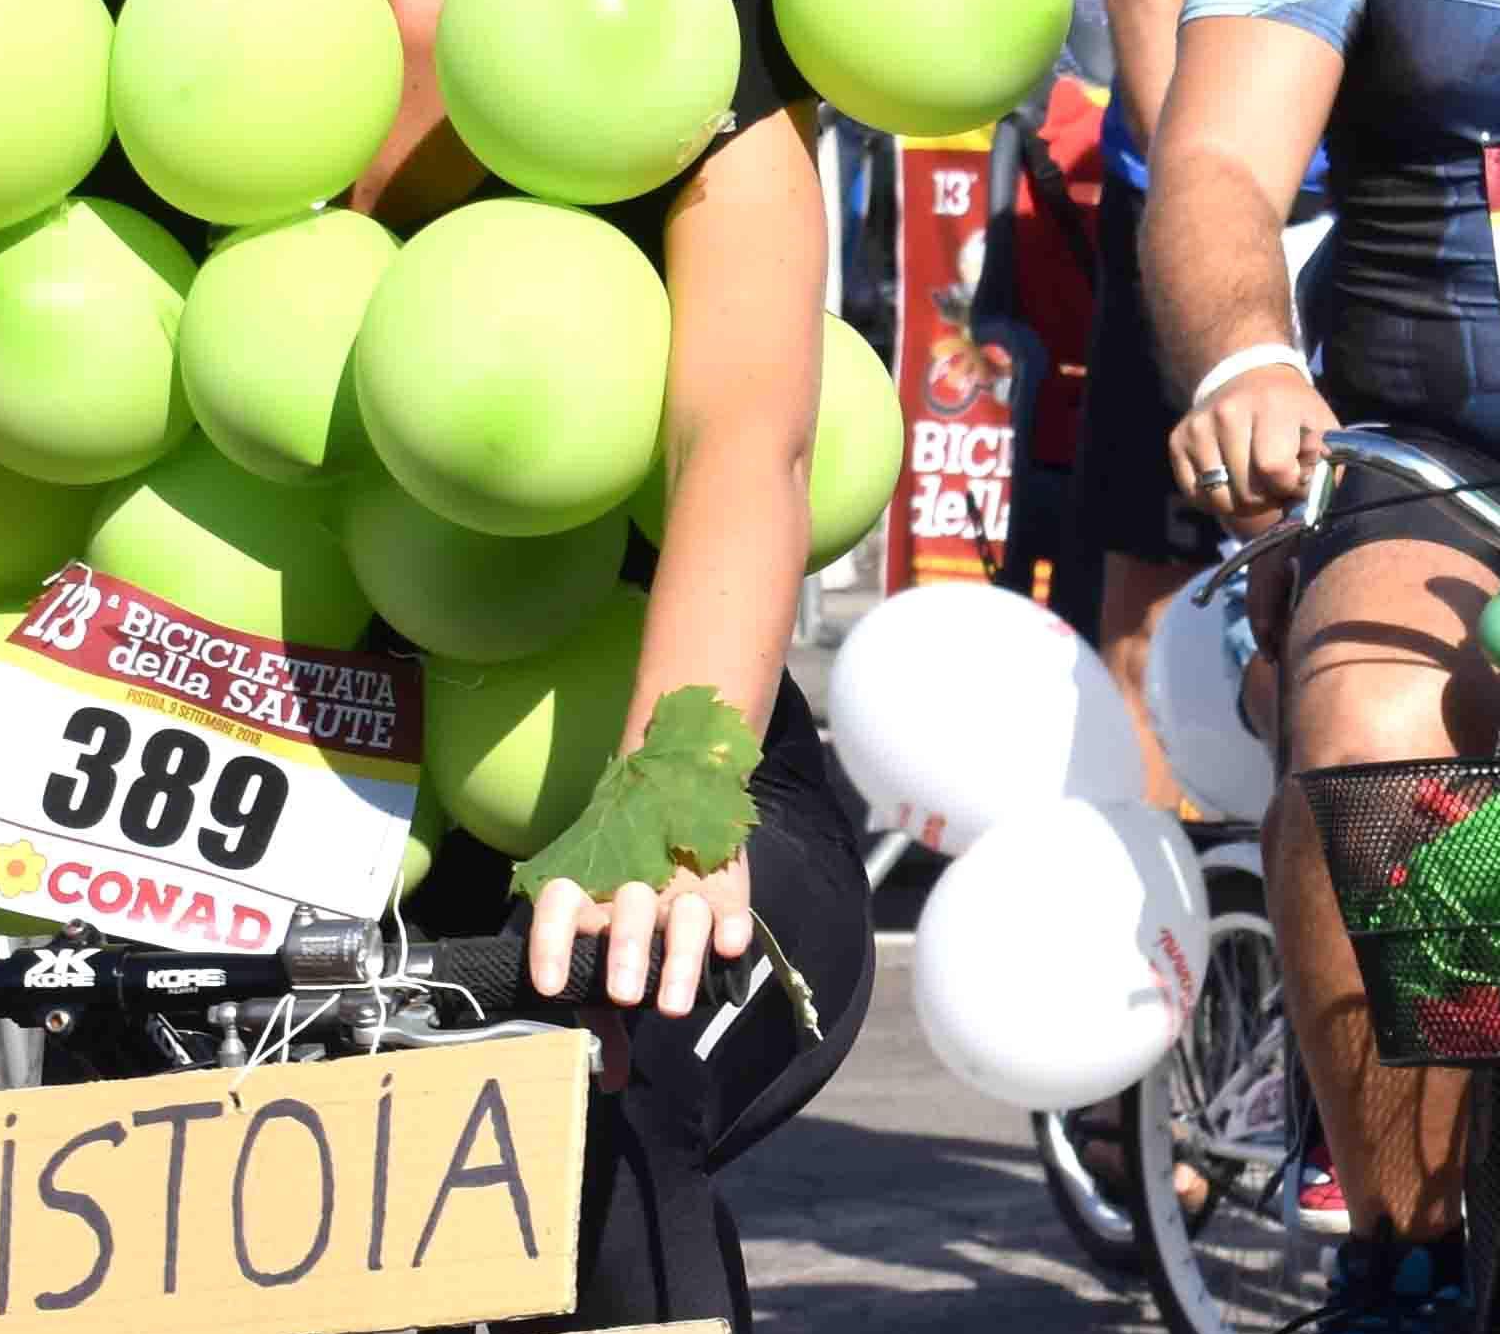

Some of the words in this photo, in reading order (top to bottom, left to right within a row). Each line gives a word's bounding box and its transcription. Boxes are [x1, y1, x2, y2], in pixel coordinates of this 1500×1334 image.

[108, 636, 211, 701] della
[222, 678, 397, 750] SALUTE
[119, 601, 397, 709] BICICLETTATA
[169, 701, 178, 715] 9
[178, 704, 235, 735] SETTEMBRE
[235, 726, 263, 747] 2018
[42, 706, 288, 870] 389
[47, 863, 274, 950] CONAD
[25, 971, 95, 988] KORE
[146, 969, 227, 988] KORE
